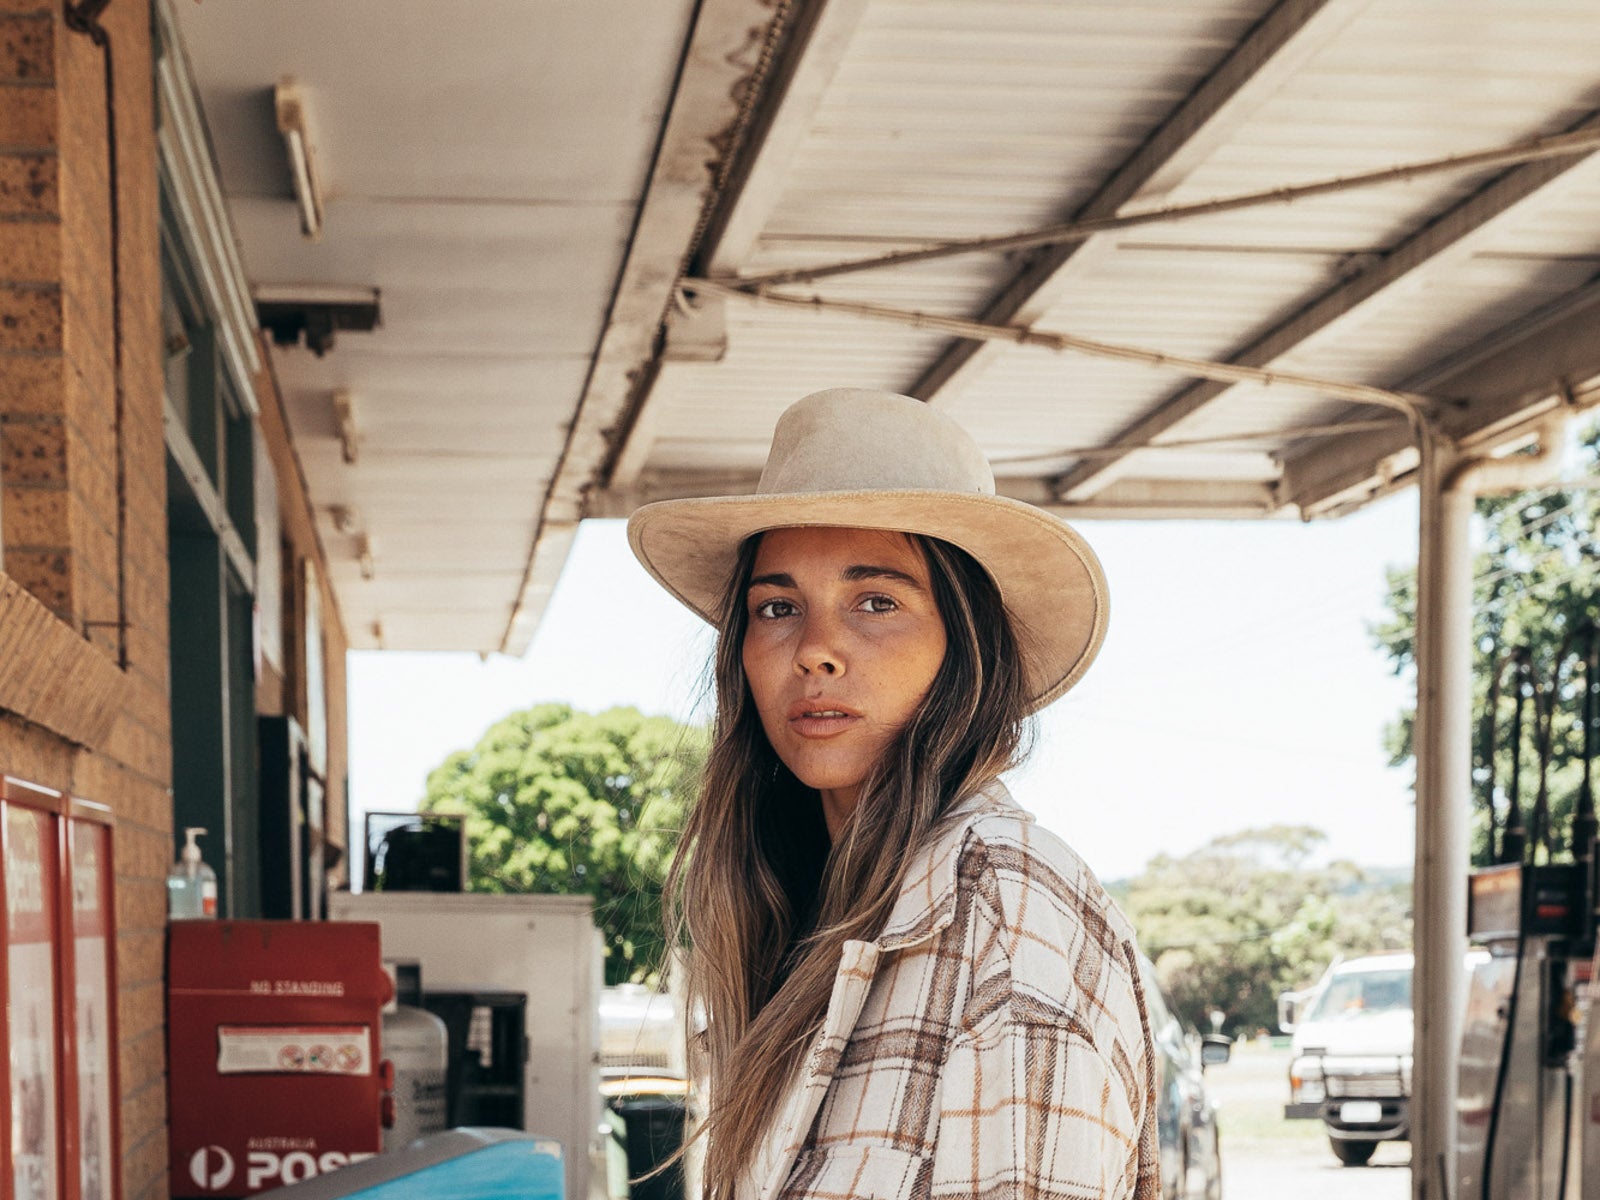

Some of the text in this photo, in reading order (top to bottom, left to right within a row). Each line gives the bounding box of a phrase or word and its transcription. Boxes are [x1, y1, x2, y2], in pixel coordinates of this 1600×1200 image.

[250, 980, 344, 998] NO STANDING
[247, 1136, 318, 1149] AUSTRALIA
[247, 1151, 377, 1188] POS
